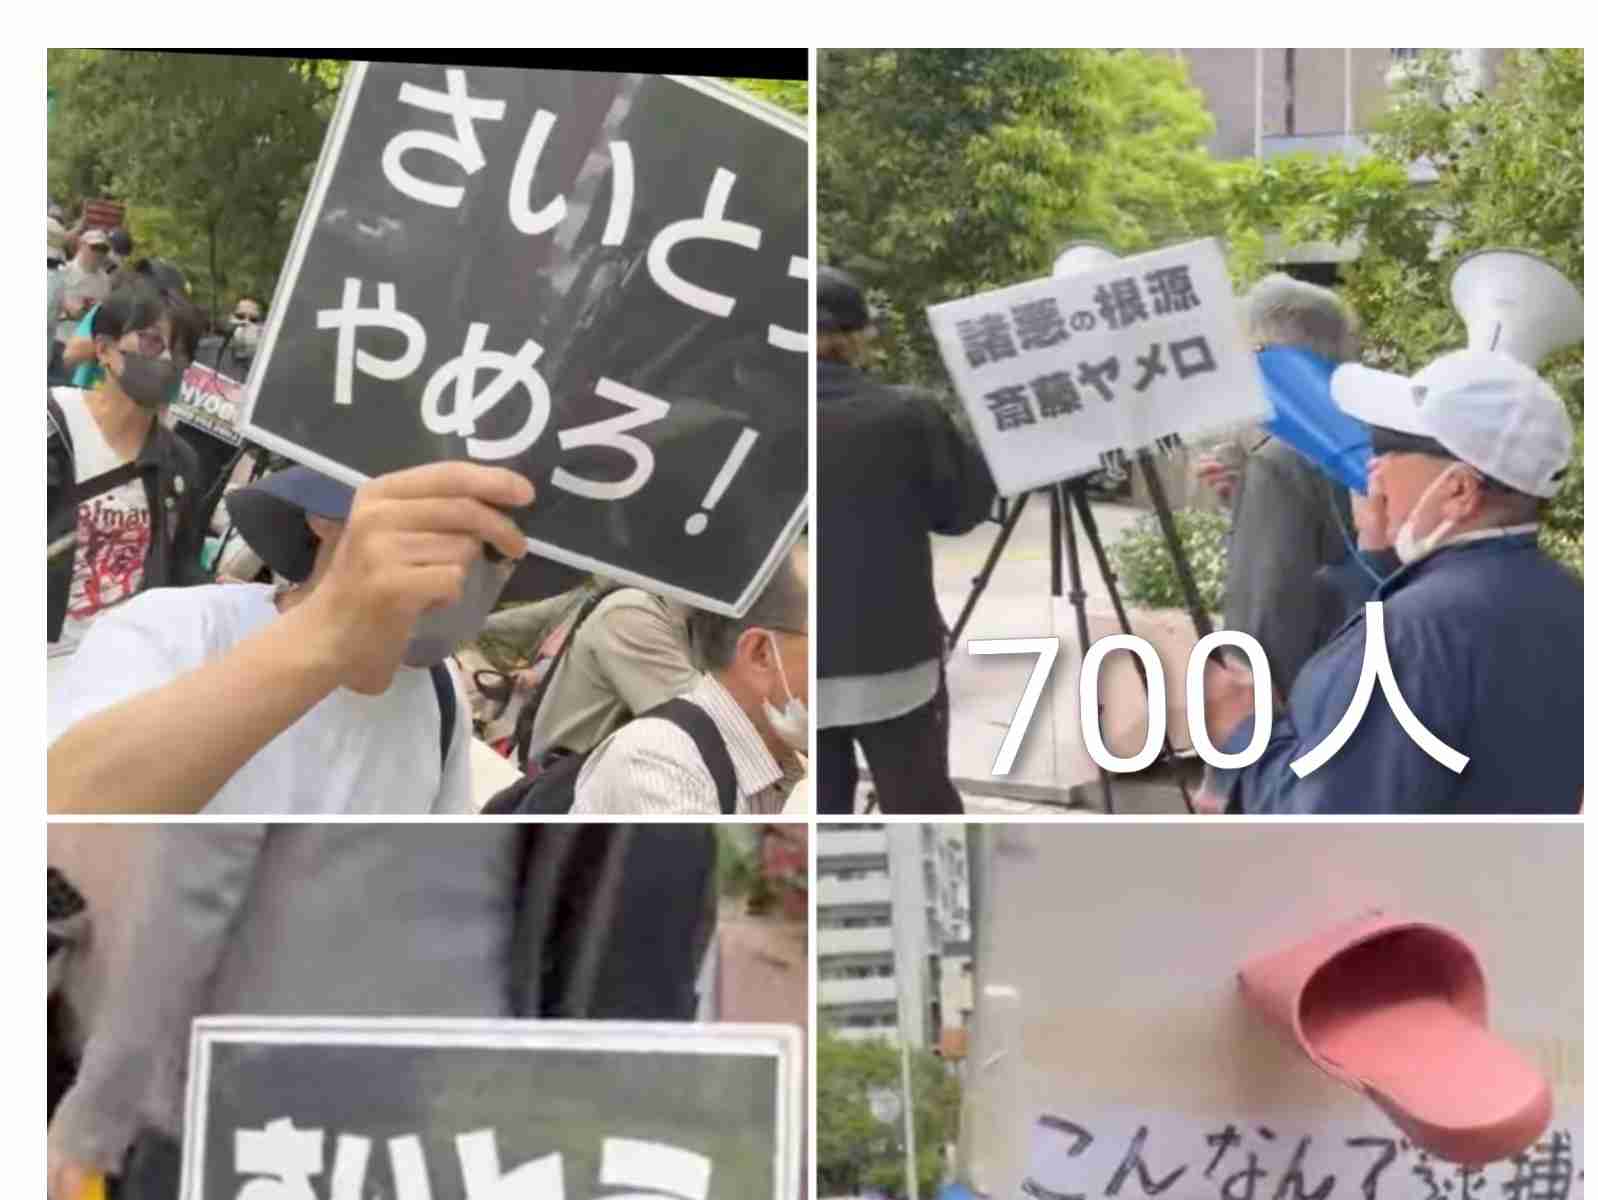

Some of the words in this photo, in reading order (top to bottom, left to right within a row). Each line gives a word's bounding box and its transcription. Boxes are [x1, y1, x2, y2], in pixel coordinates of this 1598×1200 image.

[955, 265, 1201, 368] 諸悪の根源
[317, 278, 760, 537] やめろ！
[984, 335, 1217, 432] 斎藤ヤメロ
